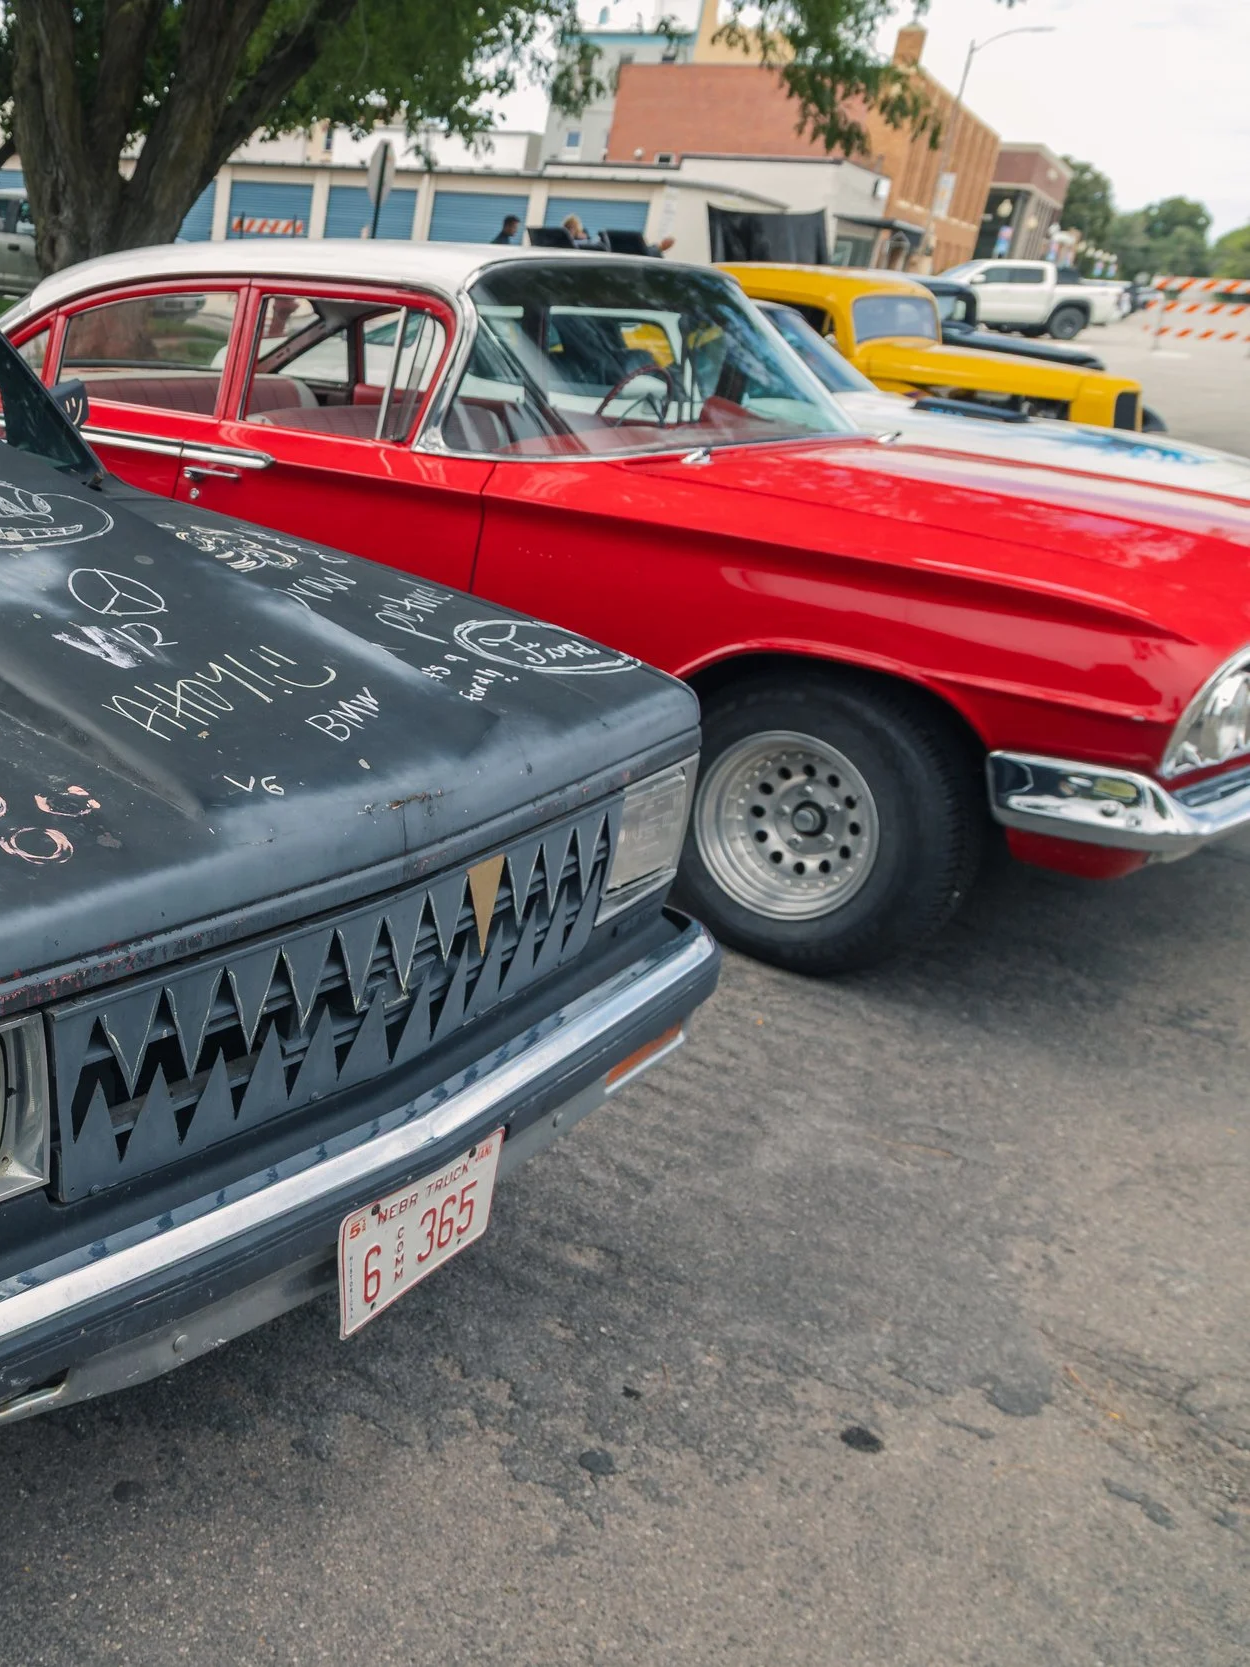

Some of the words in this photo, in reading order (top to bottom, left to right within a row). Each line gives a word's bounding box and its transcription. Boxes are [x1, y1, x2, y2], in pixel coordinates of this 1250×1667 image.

[305, 685, 381, 743] BMW
[377, 1191, 419, 1225] NEBR
[426, 1162, 469, 1197] TRUCK
[416, 1180, 478, 1263] 365
[362, 1244, 382, 1304] 6
